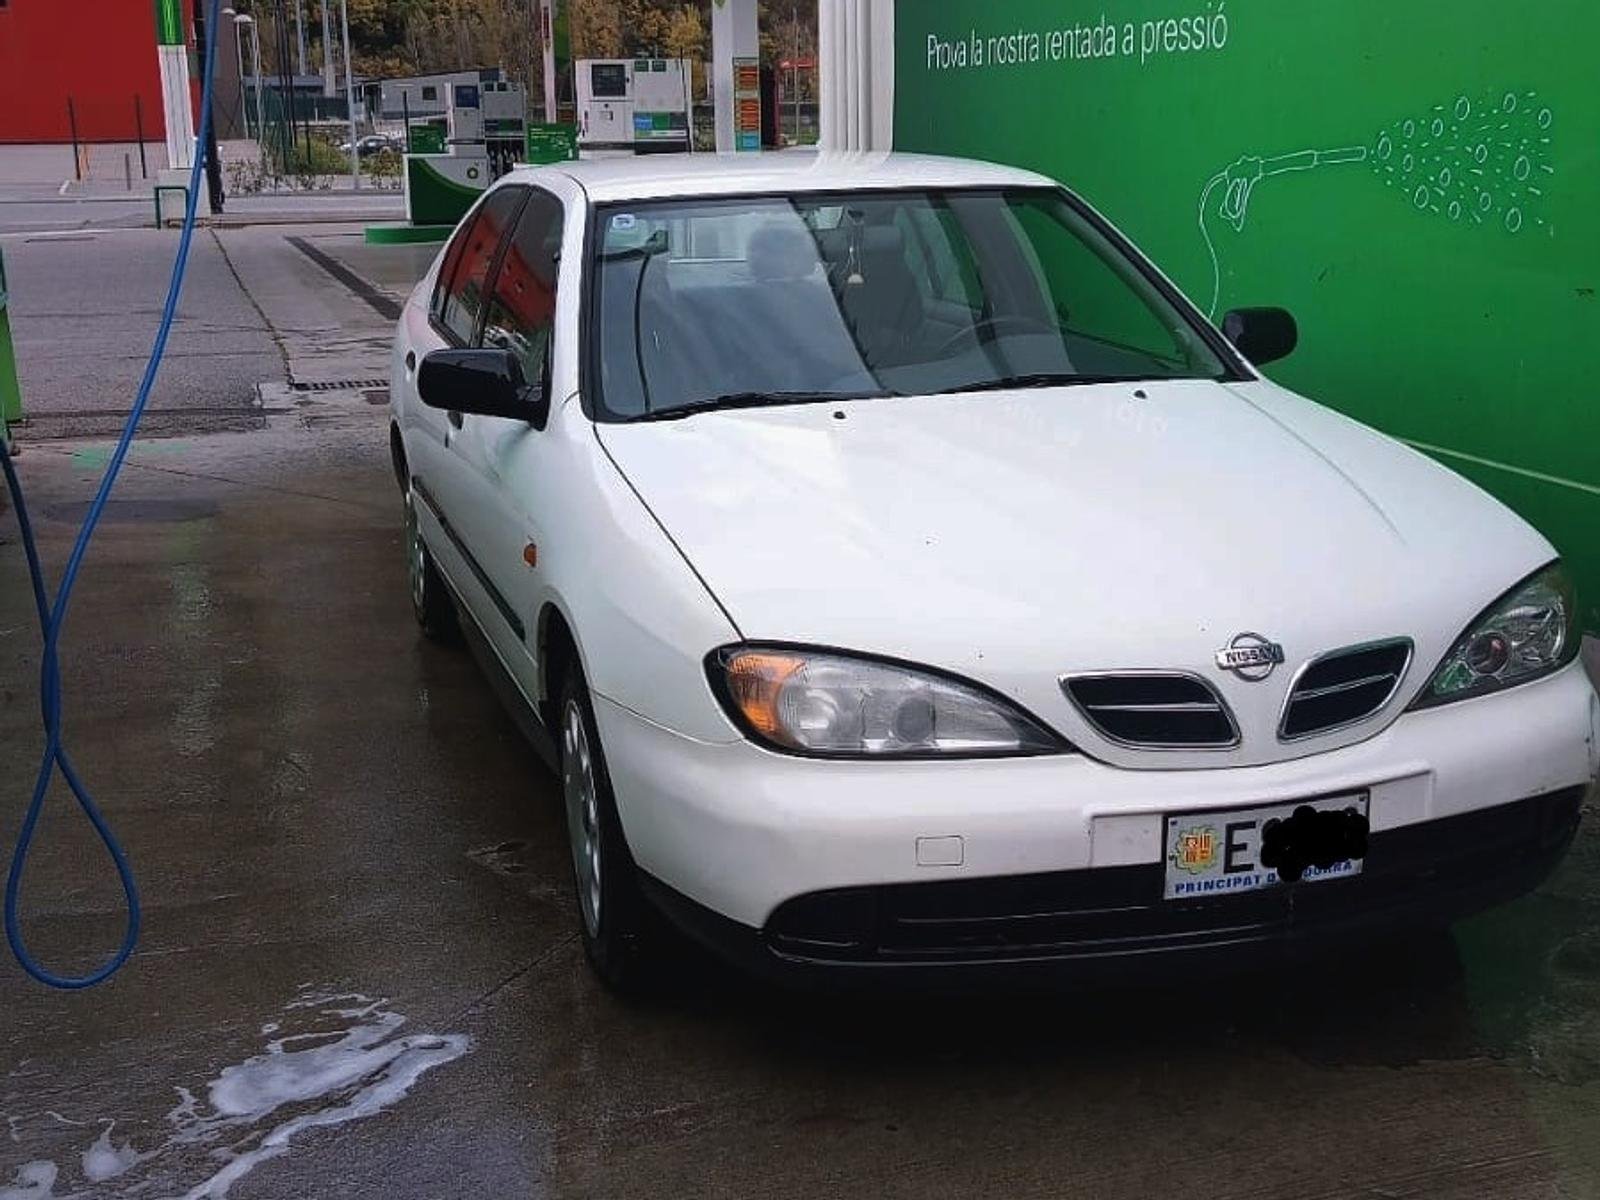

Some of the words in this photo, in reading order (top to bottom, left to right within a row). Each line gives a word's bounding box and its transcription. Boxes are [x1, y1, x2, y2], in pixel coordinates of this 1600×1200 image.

[927, 34, 966, 69] Prova
[970, 29, 983, 66] la
[988, 30, 1039, 66] nostra
[1045, 14, 1116, 60] rentada
[1122, 23, 1134, 54] a
[1141, 2, 1228, 65] pressió
[1174, 874, 1261, 894] PRINCIPAT
